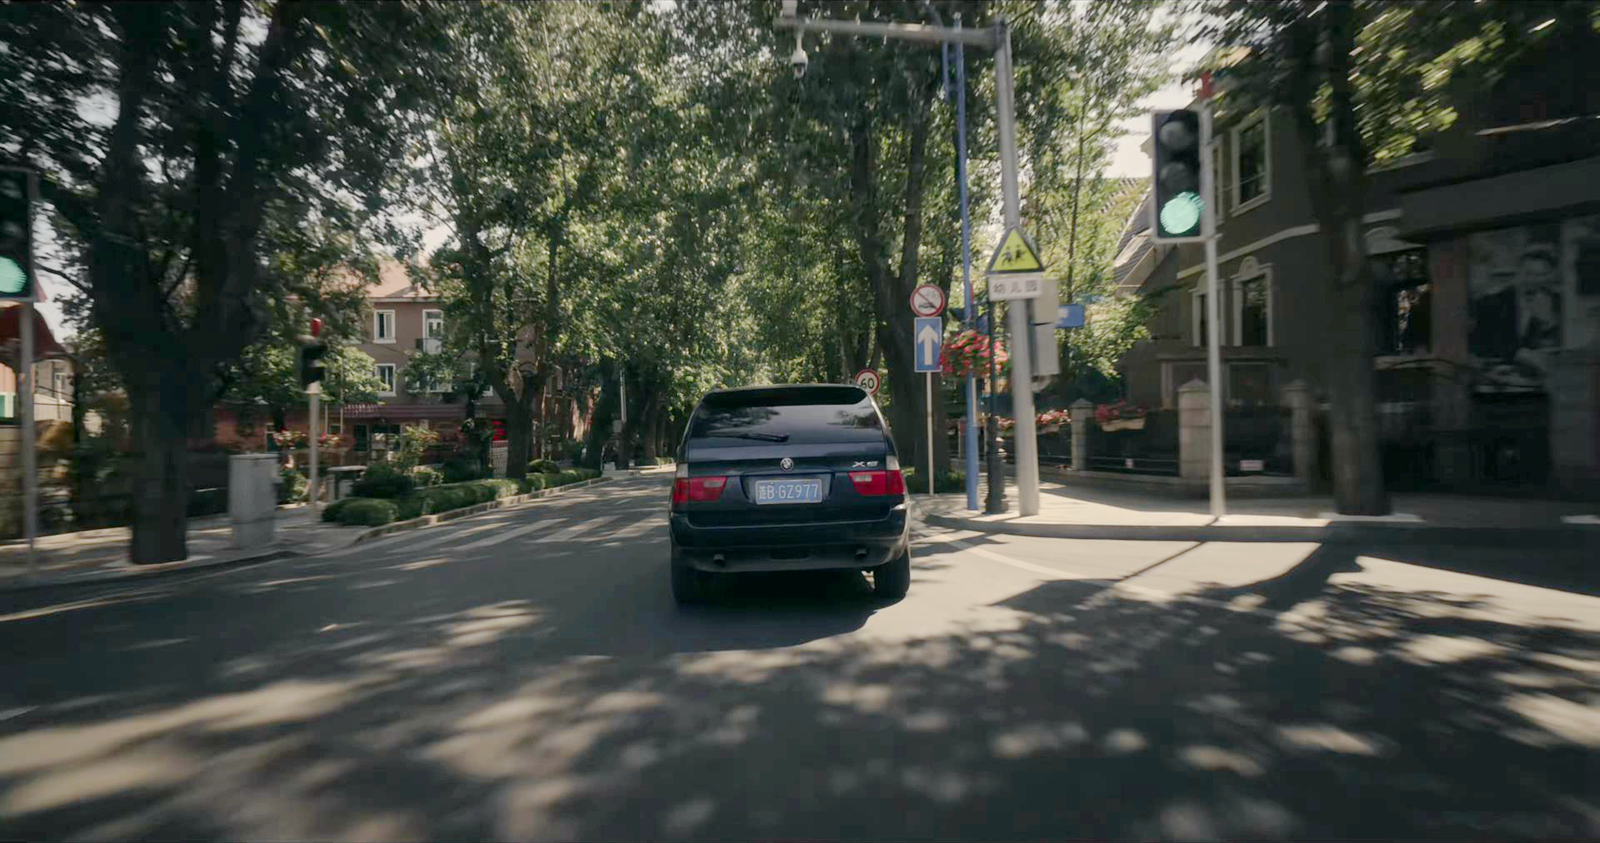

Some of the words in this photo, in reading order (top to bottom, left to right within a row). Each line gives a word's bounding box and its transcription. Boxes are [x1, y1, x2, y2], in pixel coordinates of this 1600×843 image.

[993, 280, 1038, 294] 幼儿园
[860, 377, 874, 389] 60
